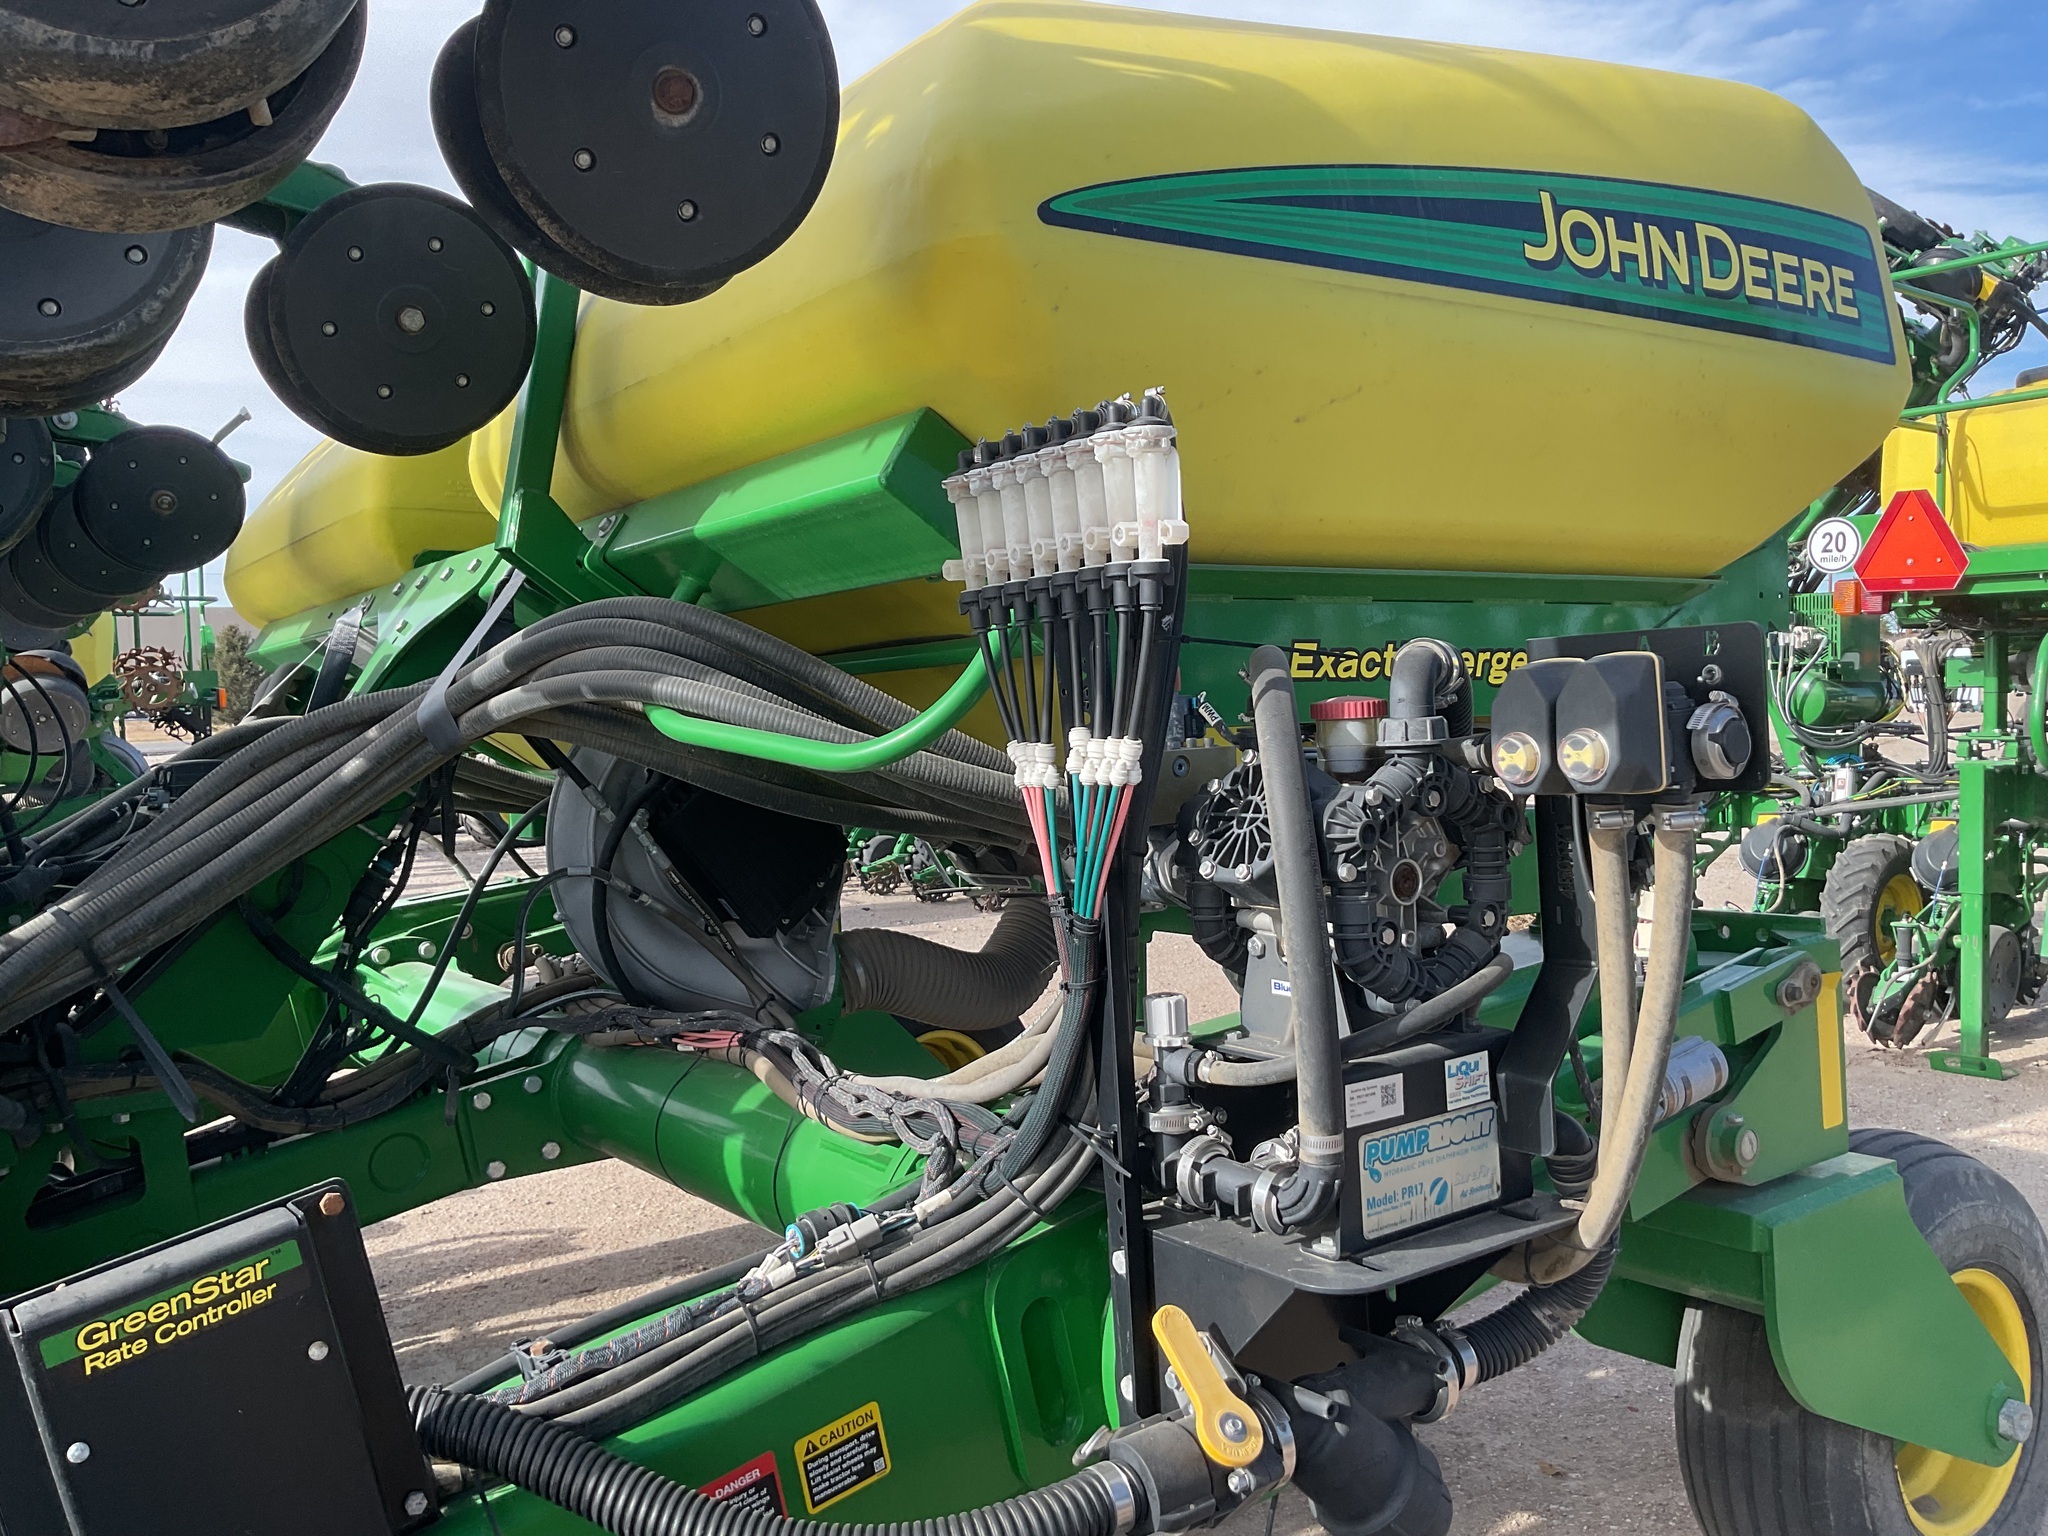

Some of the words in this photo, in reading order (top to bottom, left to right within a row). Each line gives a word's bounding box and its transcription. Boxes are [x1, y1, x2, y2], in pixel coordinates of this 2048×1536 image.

[1523, 190, 1691, 287] JOHN
[1695, 221, 1859, 319] DEERE
[1821, 531, 1847, 554] 20
[1820, 555, 1847, 564] mile/h
[1291, 641, 1528, 686] Exacterge
[1201, 702, 1219, 723] PWM
[1447, 1060, 1480, 1079] LIQUI
[1455, 1072, 1488, 1091] SHIFT
[1383, 1162, 1416, 1177] HYDRAULIC
[1417, 1157, 1434, 1169] DRIVE
[1435, 1148, 1469, 1165] DIAPHRAGM
[1470, 1141, 1489, 1154] PUMPS
[1366, 1191, 1399, 1211] Model:
[1401, 1182, 1424, 1201] PR17
[76, 1258, 270, 1352] GreenStar
[84, 1338, 148, 1376] Rate
[154, 1282, 278, 1345] Controller
[819, 1409, 874, 1447] CAUTION
[807, 1455, 829, 1470] During
[829, 1438, 860, 1458] transport,
[859, 1429, 876, 1442] drive
[809, 1463, 829, 1478] slowly
[830, 1455, 842, 1467] and
[842, 1442, 870, 1460] carefully.
[811, 1475, 822, 1486] Lift
[822, 1465, 841, 1479] assist
[841, 1453, 864, 1468] wheels
[864, 1446, 877, 1458] may
[812, 1480, 830, 1493] make
[830, 1468, 851, 1484] tractor
[851, 1461, 865, 1473] less
[714, 1468, 761, 1500] DANGER
[743, 1493, 759, 1506] clear
[760, 1487, 767, 1496] of
[748, 1486, 756, 1495] or
[813, 1474, 859, 1502] maneuverable.
[751, 1495, 771, 1509] wings
